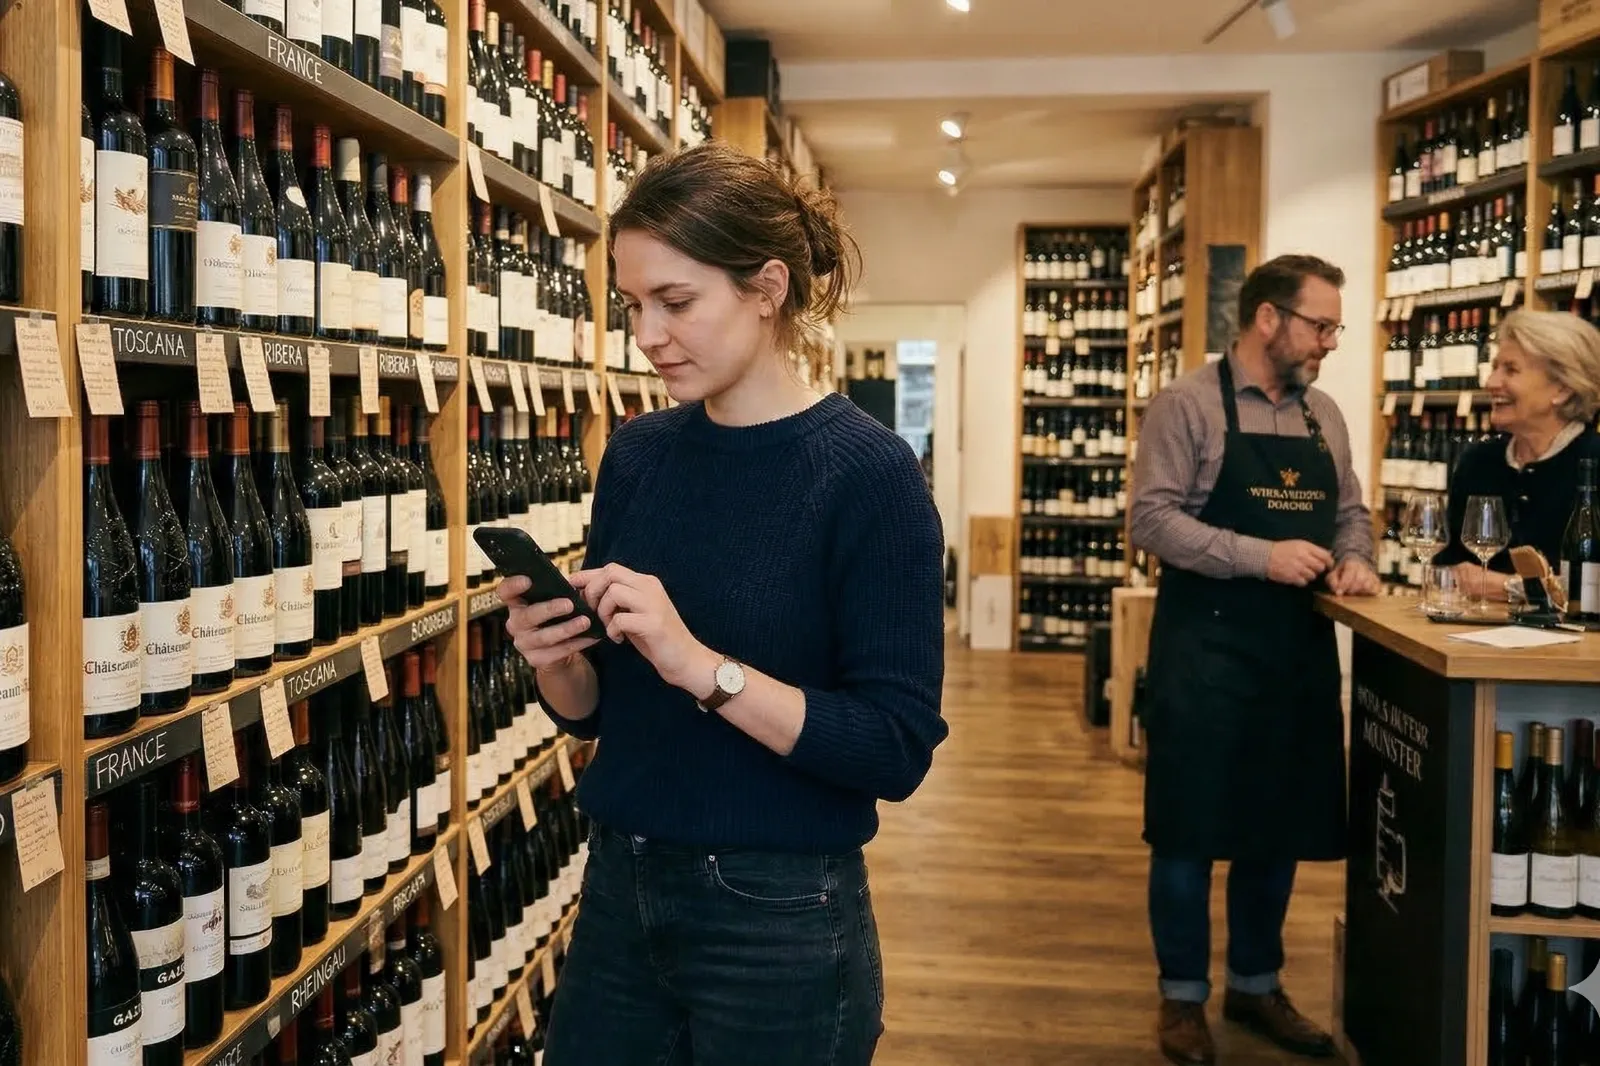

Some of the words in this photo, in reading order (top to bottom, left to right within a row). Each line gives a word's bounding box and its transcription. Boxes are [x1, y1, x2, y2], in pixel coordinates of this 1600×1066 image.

[268, 35, 323, 84] FRANCE
[113, 327, 188, 358] TOSCANA
[265, 342, 303, 366] RIBERA
[286, 664, 338, 699] TOSCANA
[96, 731, 168, 789] FRANCE
[291, 945, 346, 1015] RHEINGAU
